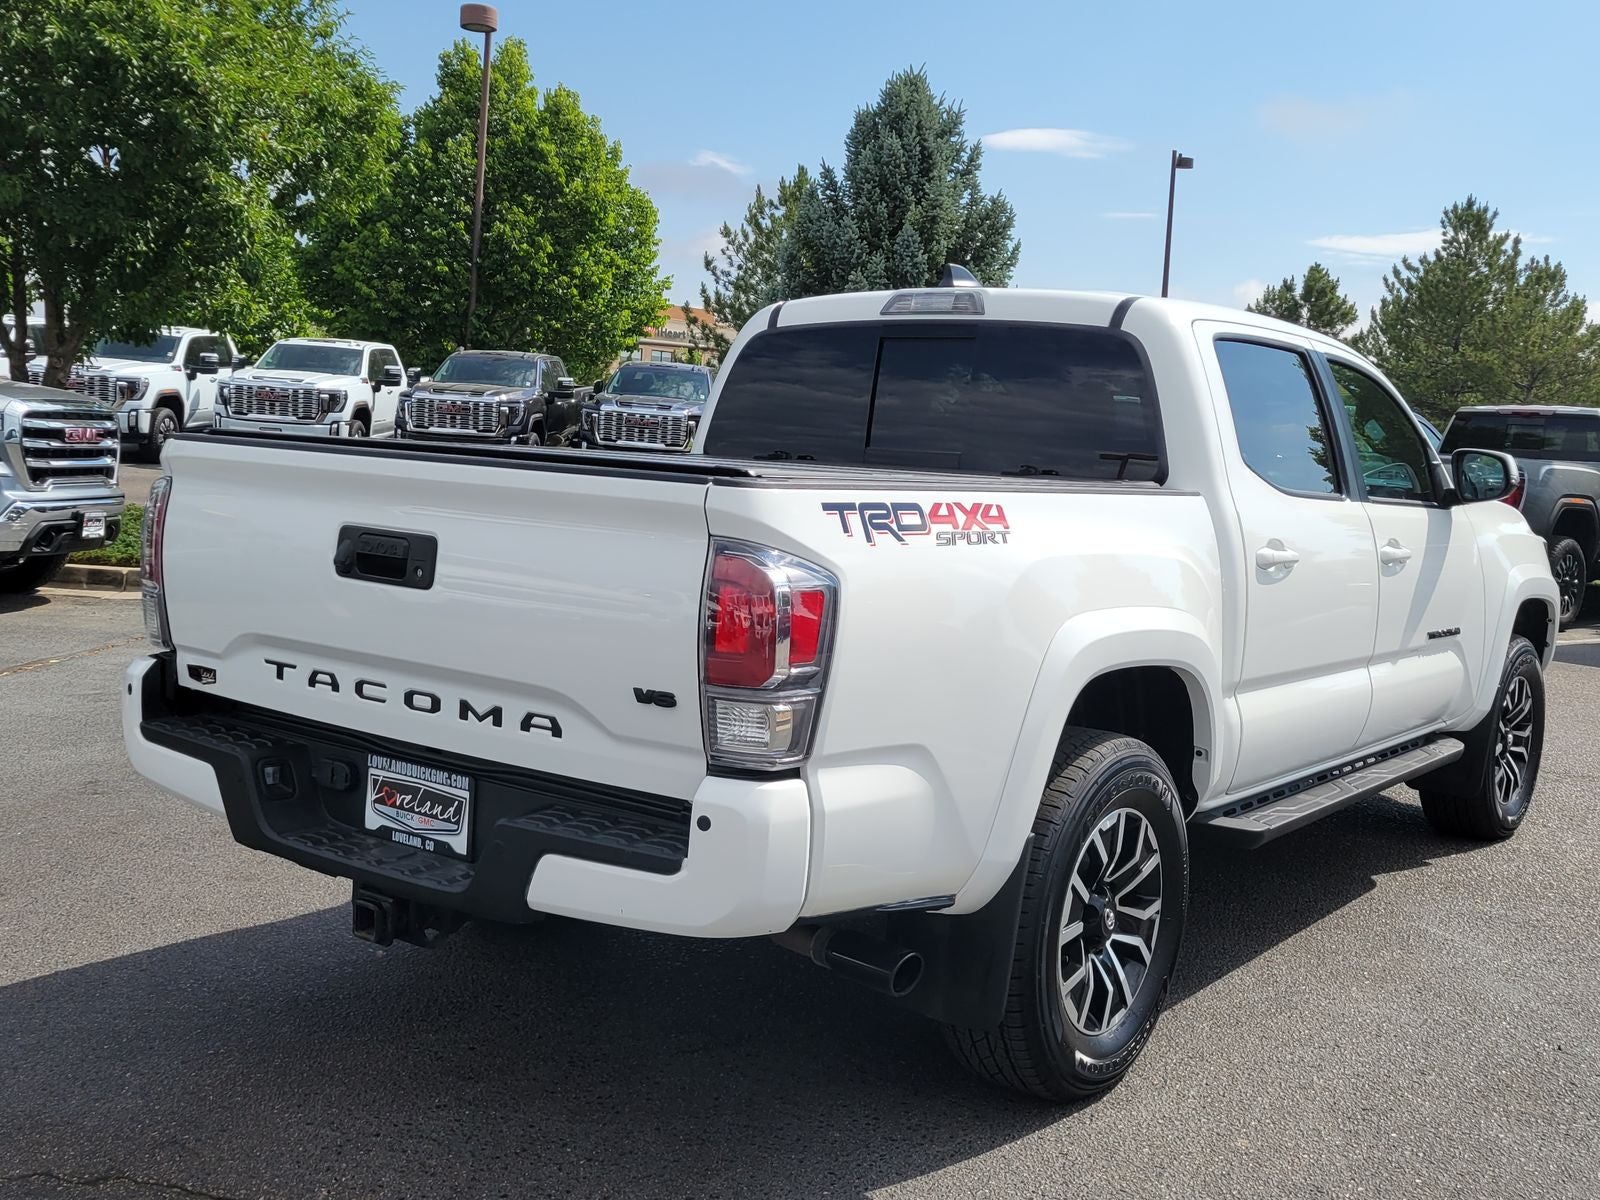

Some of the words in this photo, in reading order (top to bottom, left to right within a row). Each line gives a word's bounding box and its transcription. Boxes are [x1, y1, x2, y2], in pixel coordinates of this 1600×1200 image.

[64, 428, 104, 442] GMC
[821, 502, 931, 546] TRD
[936, 531, 1010, 546] SPORT
[264, 658, 563, 738] TACOMA
[633, 687, 677, 708] V6
[368, 754, 469, 790] LOVELANDBUICKGMC.COM
[395, 810, 415, 822] BUICK
[417, 816, 435, 827] GMC
[425, 840, 434, 851] CO
